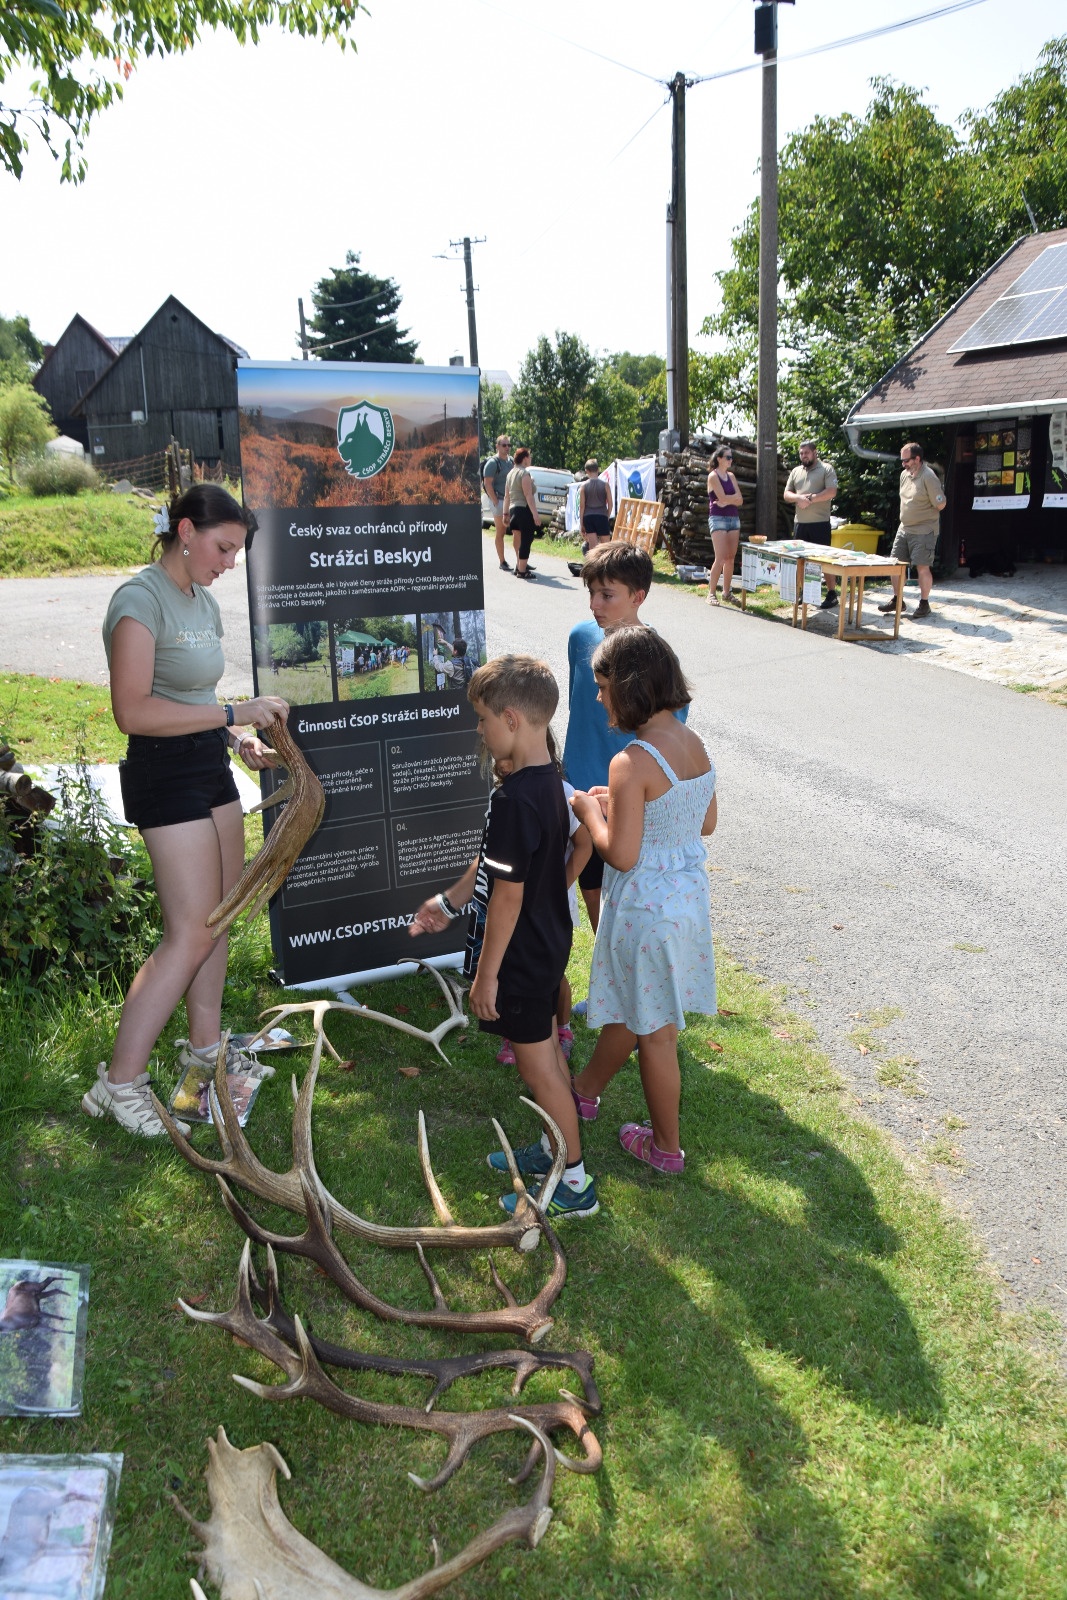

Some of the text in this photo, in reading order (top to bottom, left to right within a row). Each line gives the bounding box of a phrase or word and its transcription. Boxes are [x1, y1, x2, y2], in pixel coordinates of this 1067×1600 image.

[289, 521, 448, 538] Český svaz ochránců přírody
[310, 547, 432, 568] Strážci Beskyd
[256, 584, 294, 593] Sdružujeme
[340, 580, 359, 588] bývalé
[360, 579, 375, 587] členy
[394, 577, 414, 586] přírody
[432, 575, 454, 583] Beskydy
[257, 592, 292, 601] zpravodaje
[325, 589, 347, 598] jakožto
[351, 586, 389, 595] zaměstnance
[411, 583, 438, 592] regionální
[440, 582, 466, 590] pracoviště
[257, 601, 280, 609] Správa
[298, 704, 460, 733] Činnosti ČSOP Strážci Beskyd
[391, 746, 402, 754] 02.
[355, 768, 368, 776] péče
[439, 763, 461, 772] bývalých
[411, 774, 430, 783] přírody
[324, 786, 350, 794] hráněné
[358, 846, 374, 854] práce
[398, 846, 418, 855] přírody
